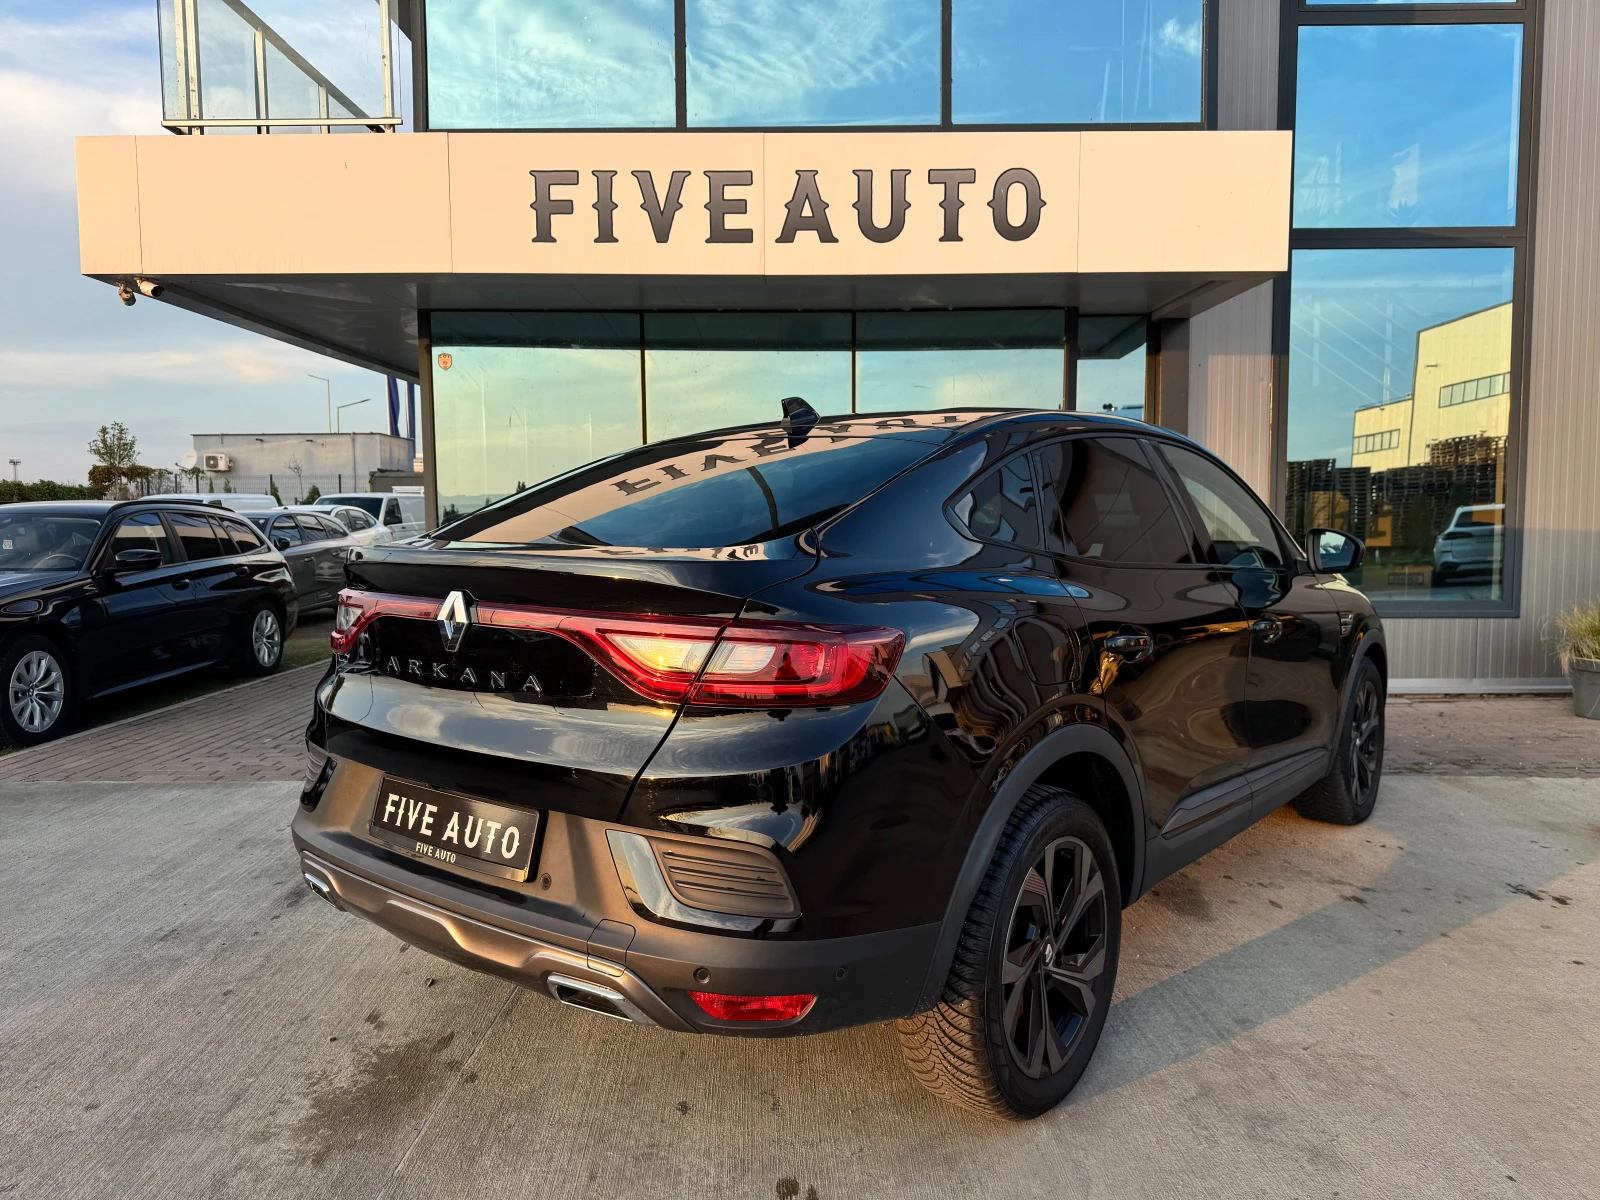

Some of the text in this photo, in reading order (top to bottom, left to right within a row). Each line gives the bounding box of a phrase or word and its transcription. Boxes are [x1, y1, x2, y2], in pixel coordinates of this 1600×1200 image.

[529, 167, 1047, 244] FIVE AUTO
[386, 656, 543, 693] ARKANA
[382, 793, 520, 859] FIVE AUTO
[415, 842, 457, 864] FIVE AUTO
